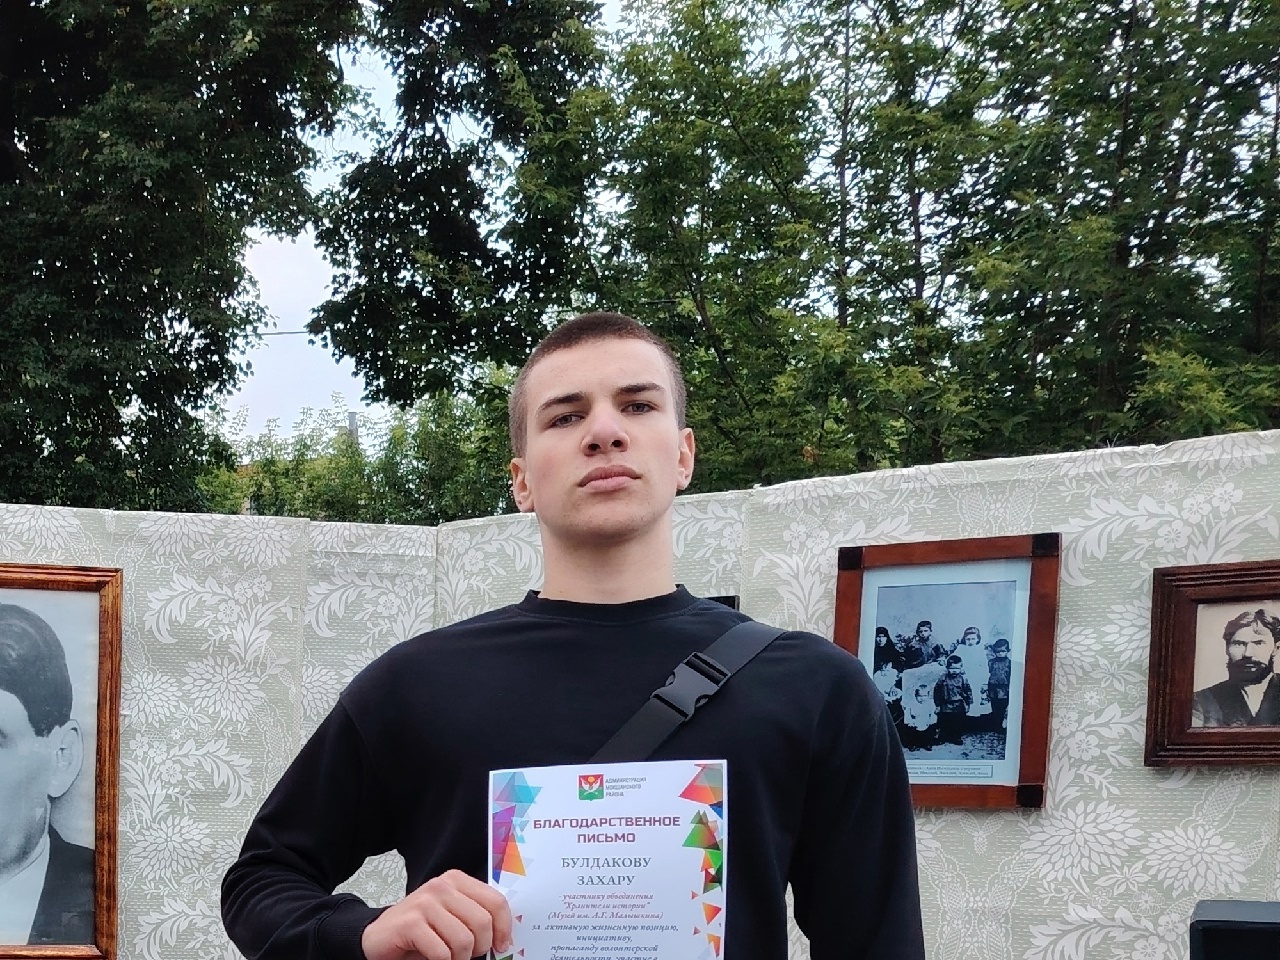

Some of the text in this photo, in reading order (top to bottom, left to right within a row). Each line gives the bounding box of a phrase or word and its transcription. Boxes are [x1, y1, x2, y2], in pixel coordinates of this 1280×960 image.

[533, 816, 681, 830] БЛАГОДАРСТВЕННОЕ
[577, 832, 635, 844] ПИСЬМО
[560, 857, 652, 870] БУЛДАКОВУ
[577, 875, 635, 886] ЗАХАРУ
